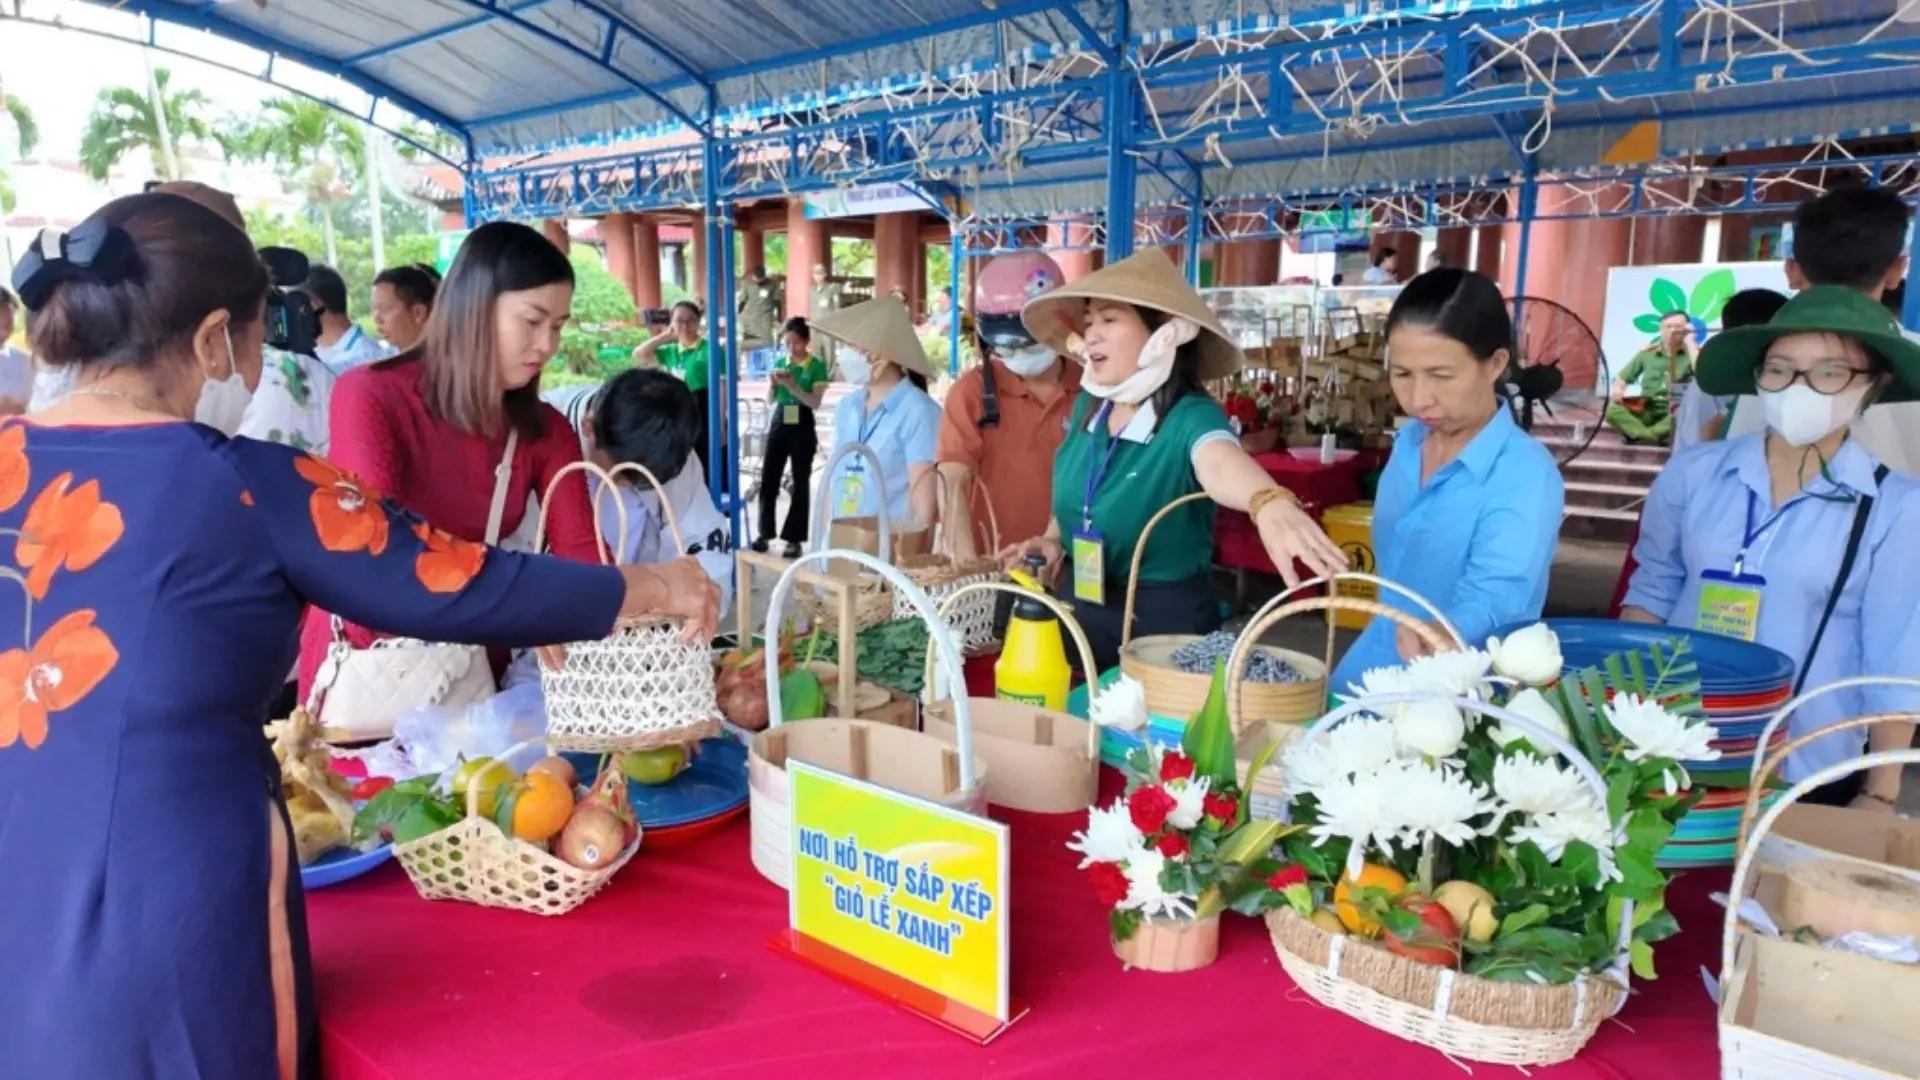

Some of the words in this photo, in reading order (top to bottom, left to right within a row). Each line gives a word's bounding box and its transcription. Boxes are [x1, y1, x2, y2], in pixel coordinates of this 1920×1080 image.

[799, 828, 828, 861] NƠI
[834, 836, 857, 872] HỖ
[863, 851, 899, 893] TRỢ
[905, 862, 944, 902] SẮP
[952, 881, 992, 920] XẾP
[869, 893, 890, 930] LỄ
